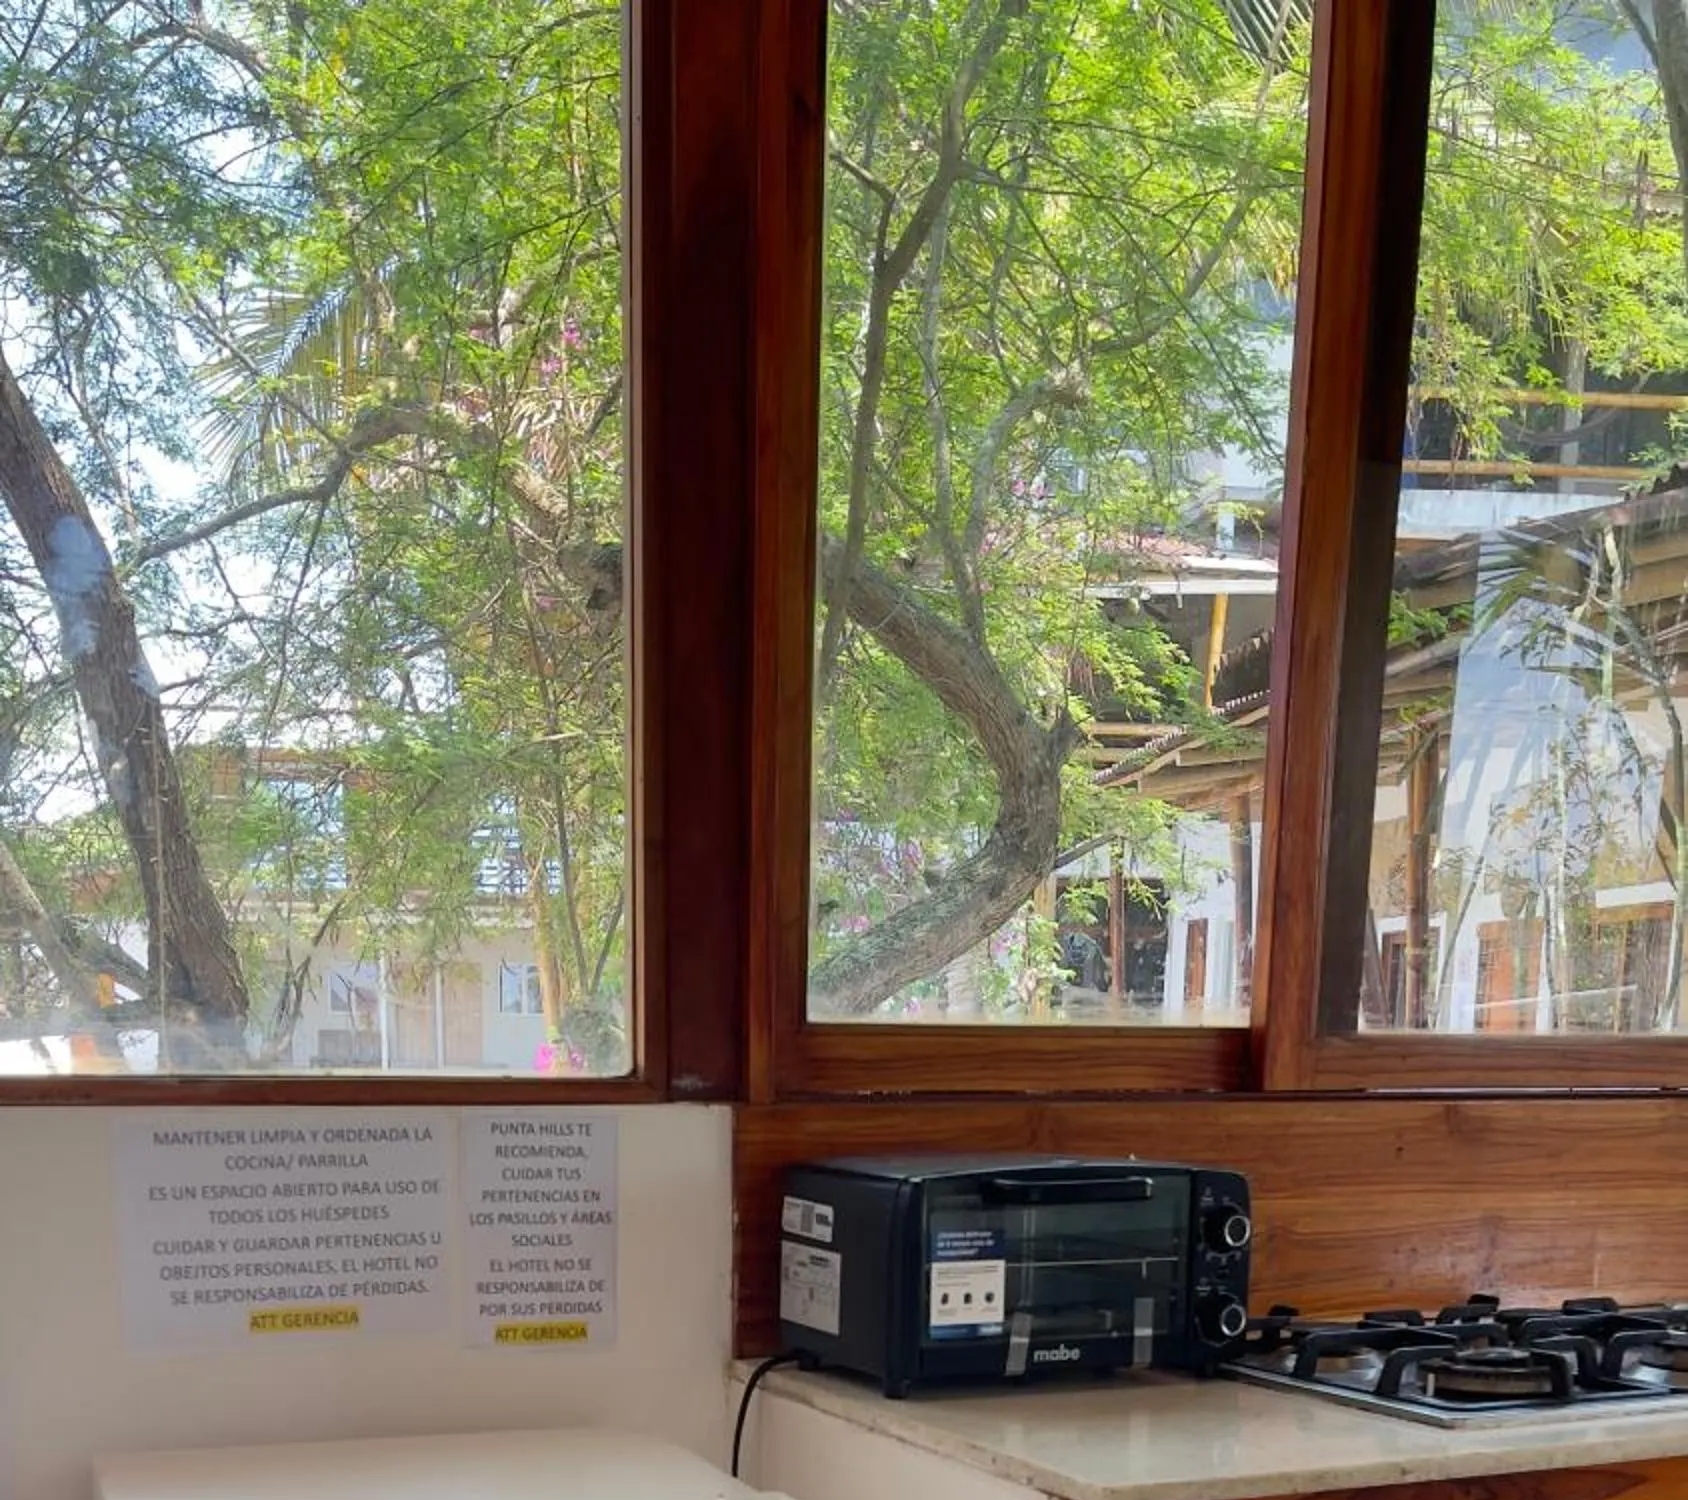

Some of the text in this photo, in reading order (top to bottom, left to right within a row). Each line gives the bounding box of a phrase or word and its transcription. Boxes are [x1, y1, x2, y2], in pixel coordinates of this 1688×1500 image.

[153, 1126, 432, 1146] MANTENER LIMPIA Y ORDENADA LA
[490, 1121, 592, 1137] PUNTA HILLS TE
[298, 1153, 368, 1169] PARRILLA
[501, 1167, 582, 1181] CUIDAR TUS
[149, 1179, 440, 1200] ES UN ESPACIO ABIERTO PARA USO DE
[481, 1188, 601, 1204] PERTENENCIAS EN
[208, 1205, 390, 1225] TODOS LOS HUÉSPEDES
[469, 1211, 494, 1228] LOS
[497, 1211, 557, 1226] PASILLOS
[559, 1212, 568, 1225] Y
[152, 1231, 441, 1256] CUIDAR Y GUARDAR PERTENENCIAS U
[511, 1233, 573, 1247] SOCIALES
[342, 1257, 360, 1274] EL
[363, 1256, 411, 1272] HOTEL
[415, 1254, 439, 1270] NO
[489, 1257, 592, 1273] EL HOTEL NO SE
[170, 1289, 189, 1306] SE
[193, 1284, 324, 1305] RESPONSABILIZA
[328, 1283, 349, 1298] DE
[477, 1278, 605, 1295] RESPONSABILIZA DE
[479, 1302, 507, 1317] POR
[510, 1301, 537, 1316] SUS
[249, 1311, 359, 1332] ATT GERENCIA
[495, 1325, 588, 1343] ATT GERENCIA
[1033, 1343, 1080, 1363] mabe
